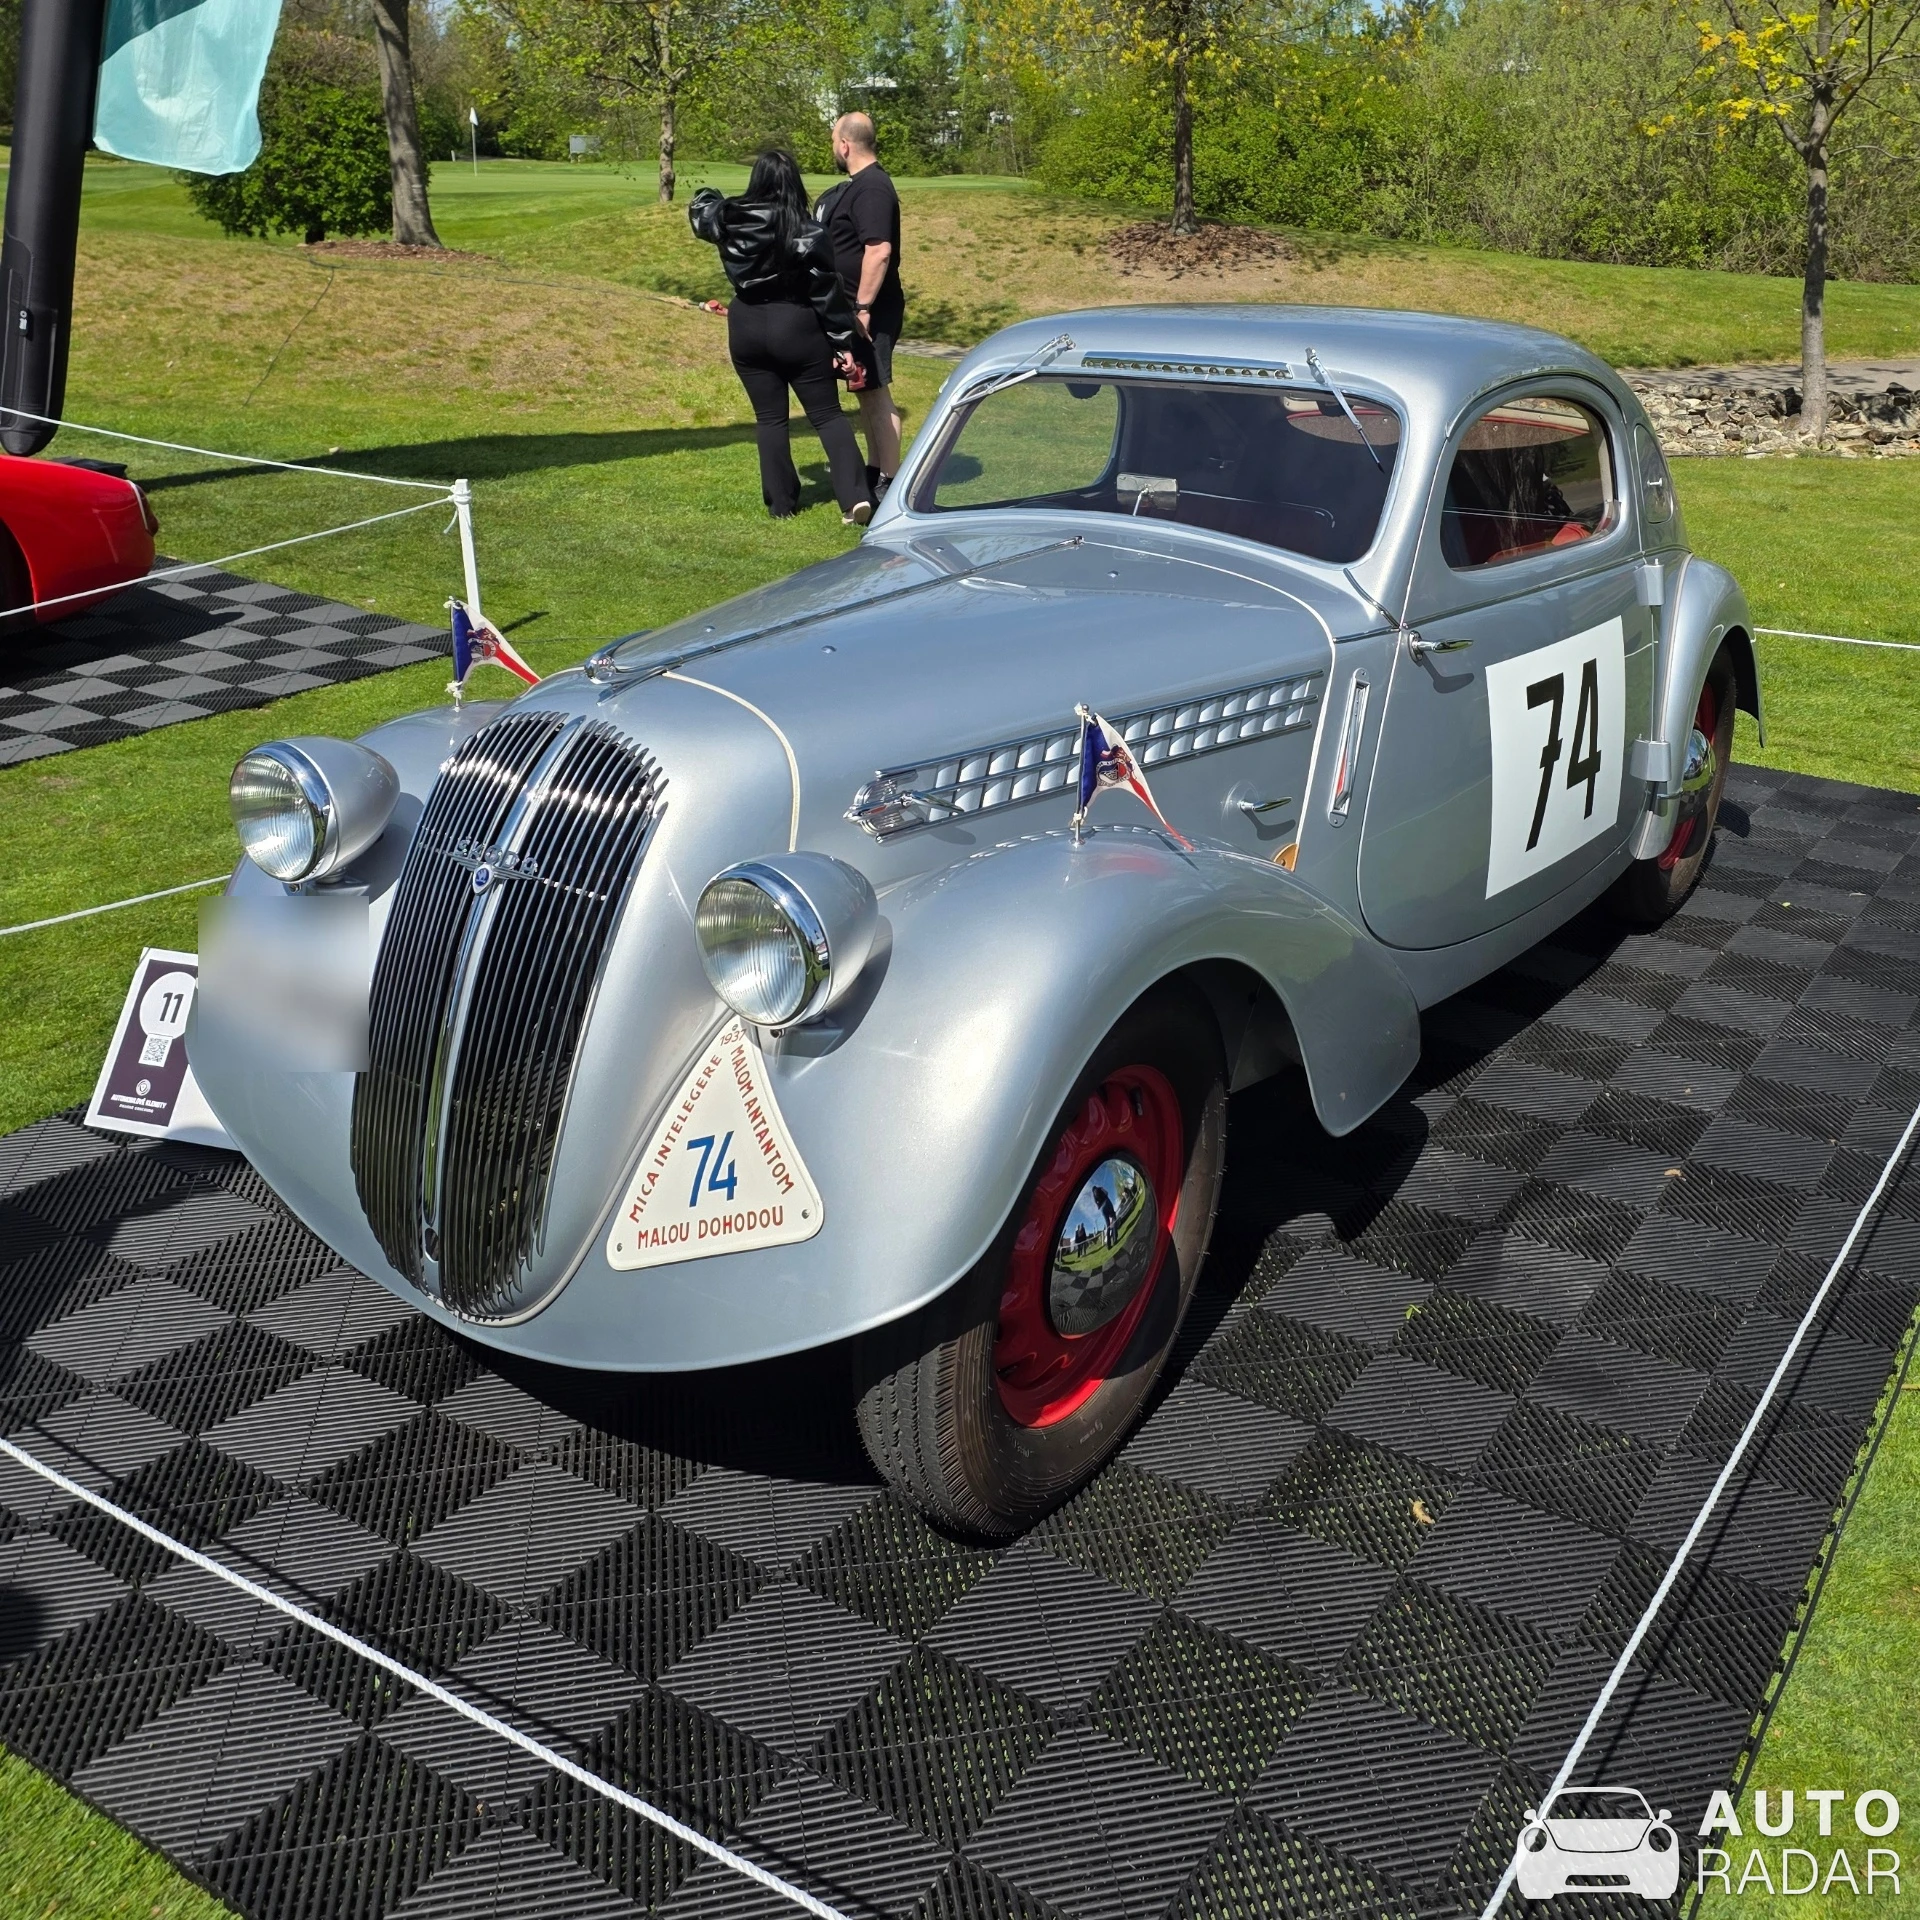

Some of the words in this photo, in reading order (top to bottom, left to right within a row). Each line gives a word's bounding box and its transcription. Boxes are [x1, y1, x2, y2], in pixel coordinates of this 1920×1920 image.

[1525, 658, 1602, 853] 74
[159, 992, 185, 1024] 11
[720, 1028, 747, 1047] 1937
[629, 1172, 659, 1223] MICA
[654, 1055, 722, 1167] INTELEGERE
[731, 1044, 755, 1098] MALOM
[744, 1097, 794, 1195] ANTANTOM
[686, 1130, 738, 1208] 74
[637, 1221, 690, 1250] MALOU
[698, 1205, 784, 1240] DOHODOU
